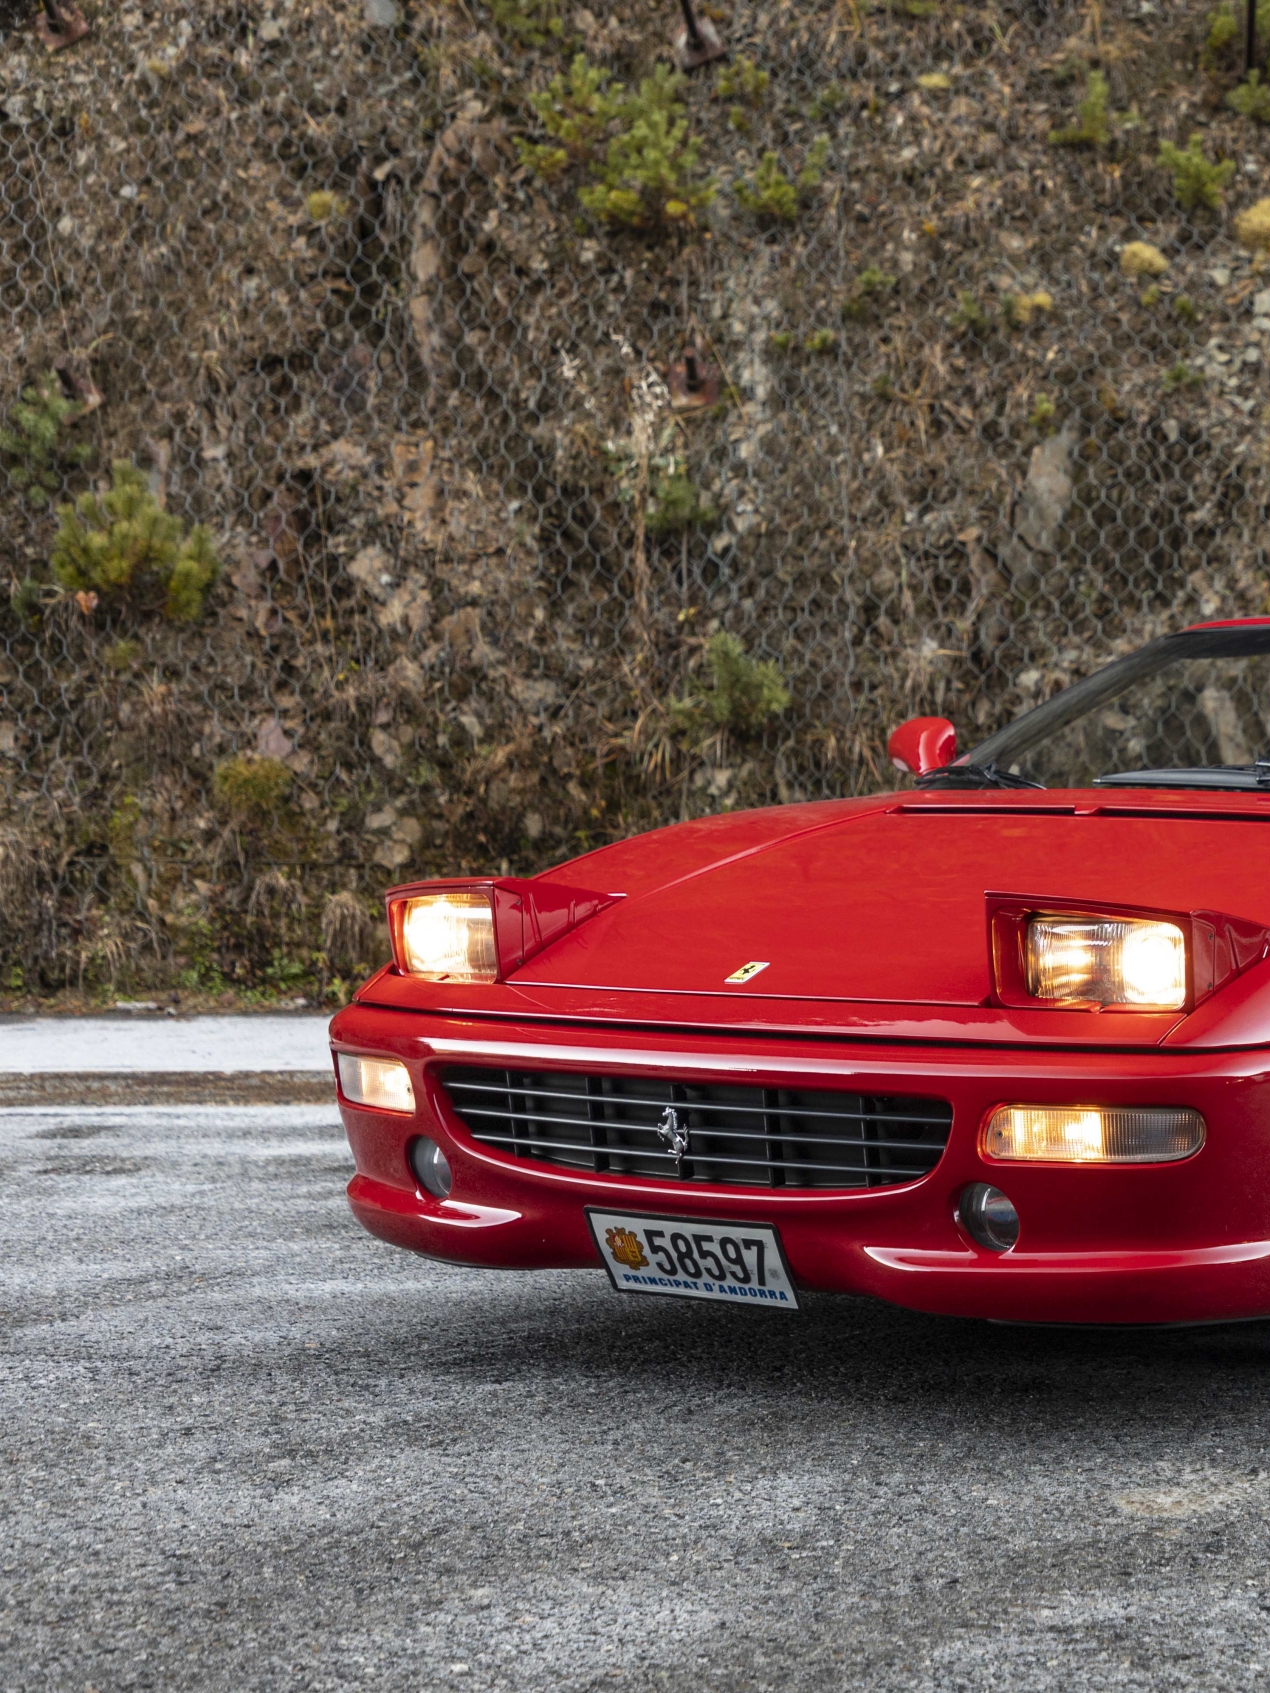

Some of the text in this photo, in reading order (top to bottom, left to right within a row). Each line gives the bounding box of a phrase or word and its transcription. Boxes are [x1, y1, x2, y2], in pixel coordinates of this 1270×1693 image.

[643, 1229, 766, 1287] 58597
[623, 1273, 789, 1301] PRINCIPAT D'ANDORRA
